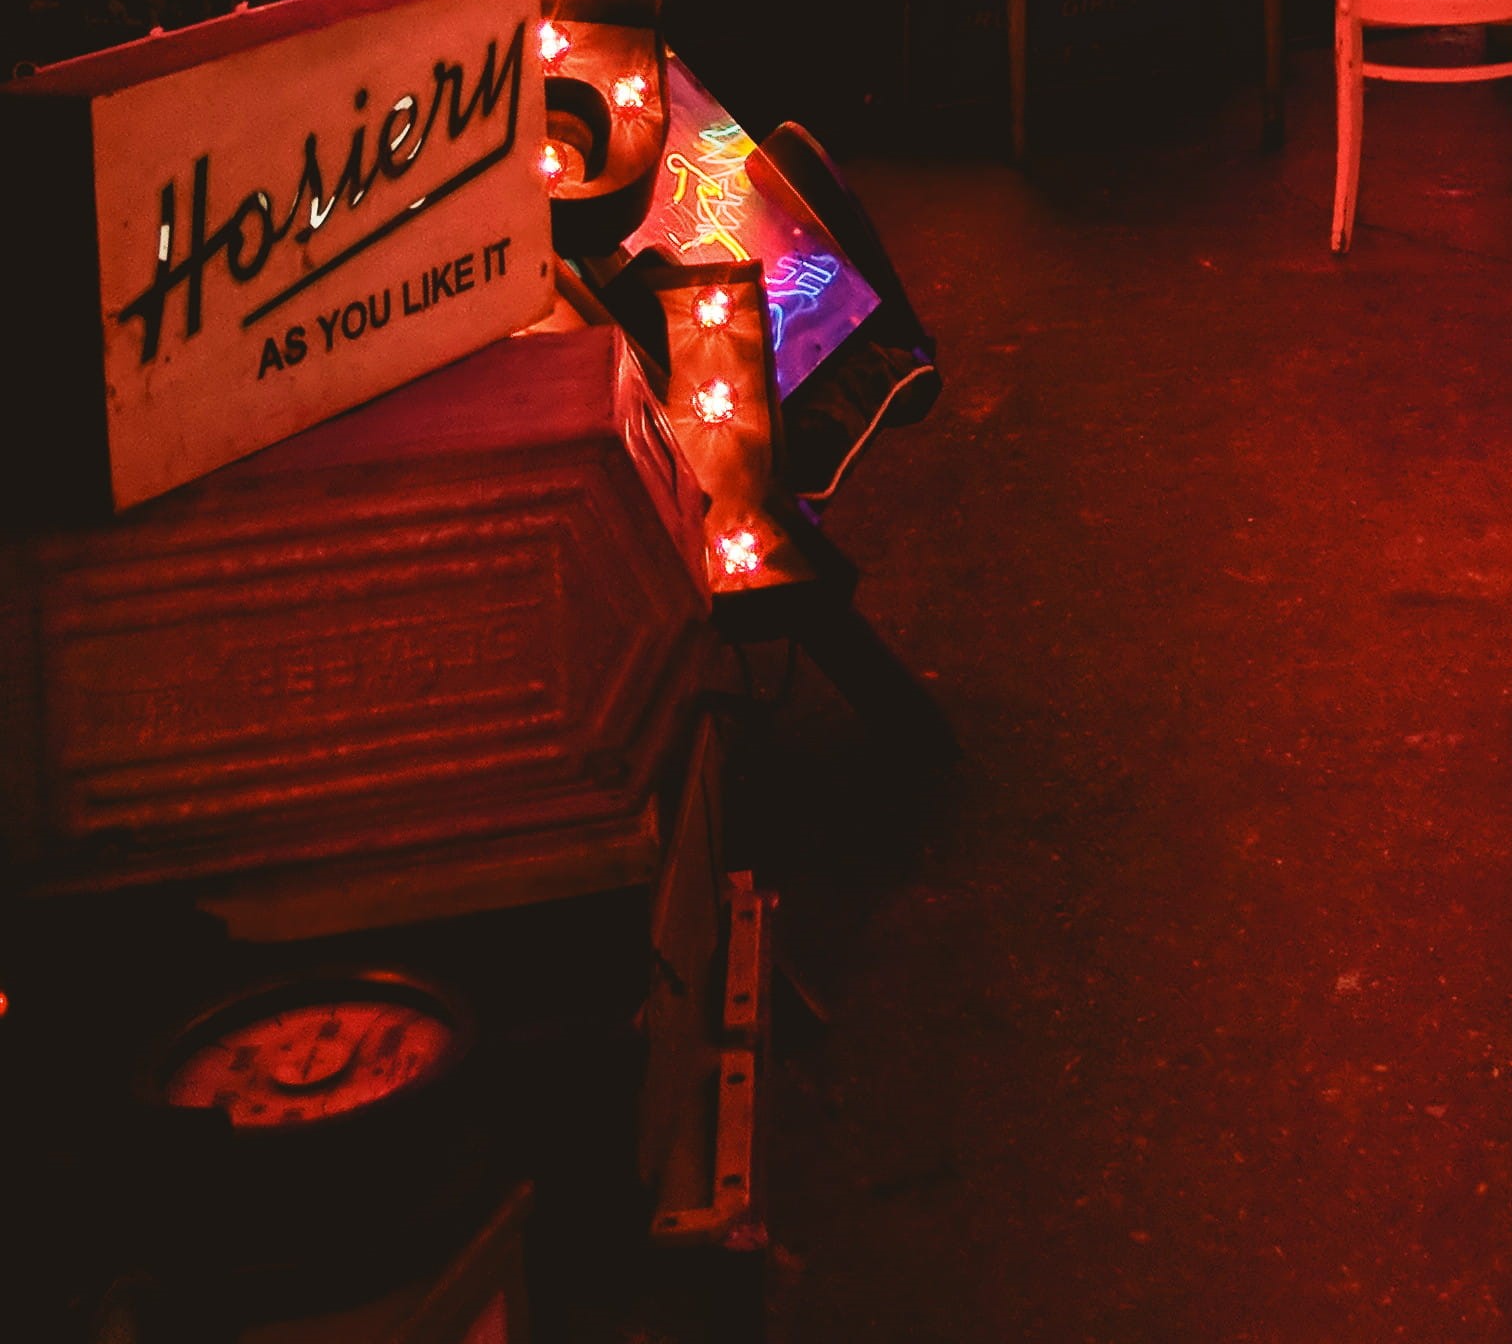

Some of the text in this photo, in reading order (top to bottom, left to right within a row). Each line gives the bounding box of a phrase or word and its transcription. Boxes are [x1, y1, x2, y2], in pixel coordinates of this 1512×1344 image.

[117, 20, 527, 365] Hosiery
[256, 237, 513, 379] AS YOU LIKE IT
